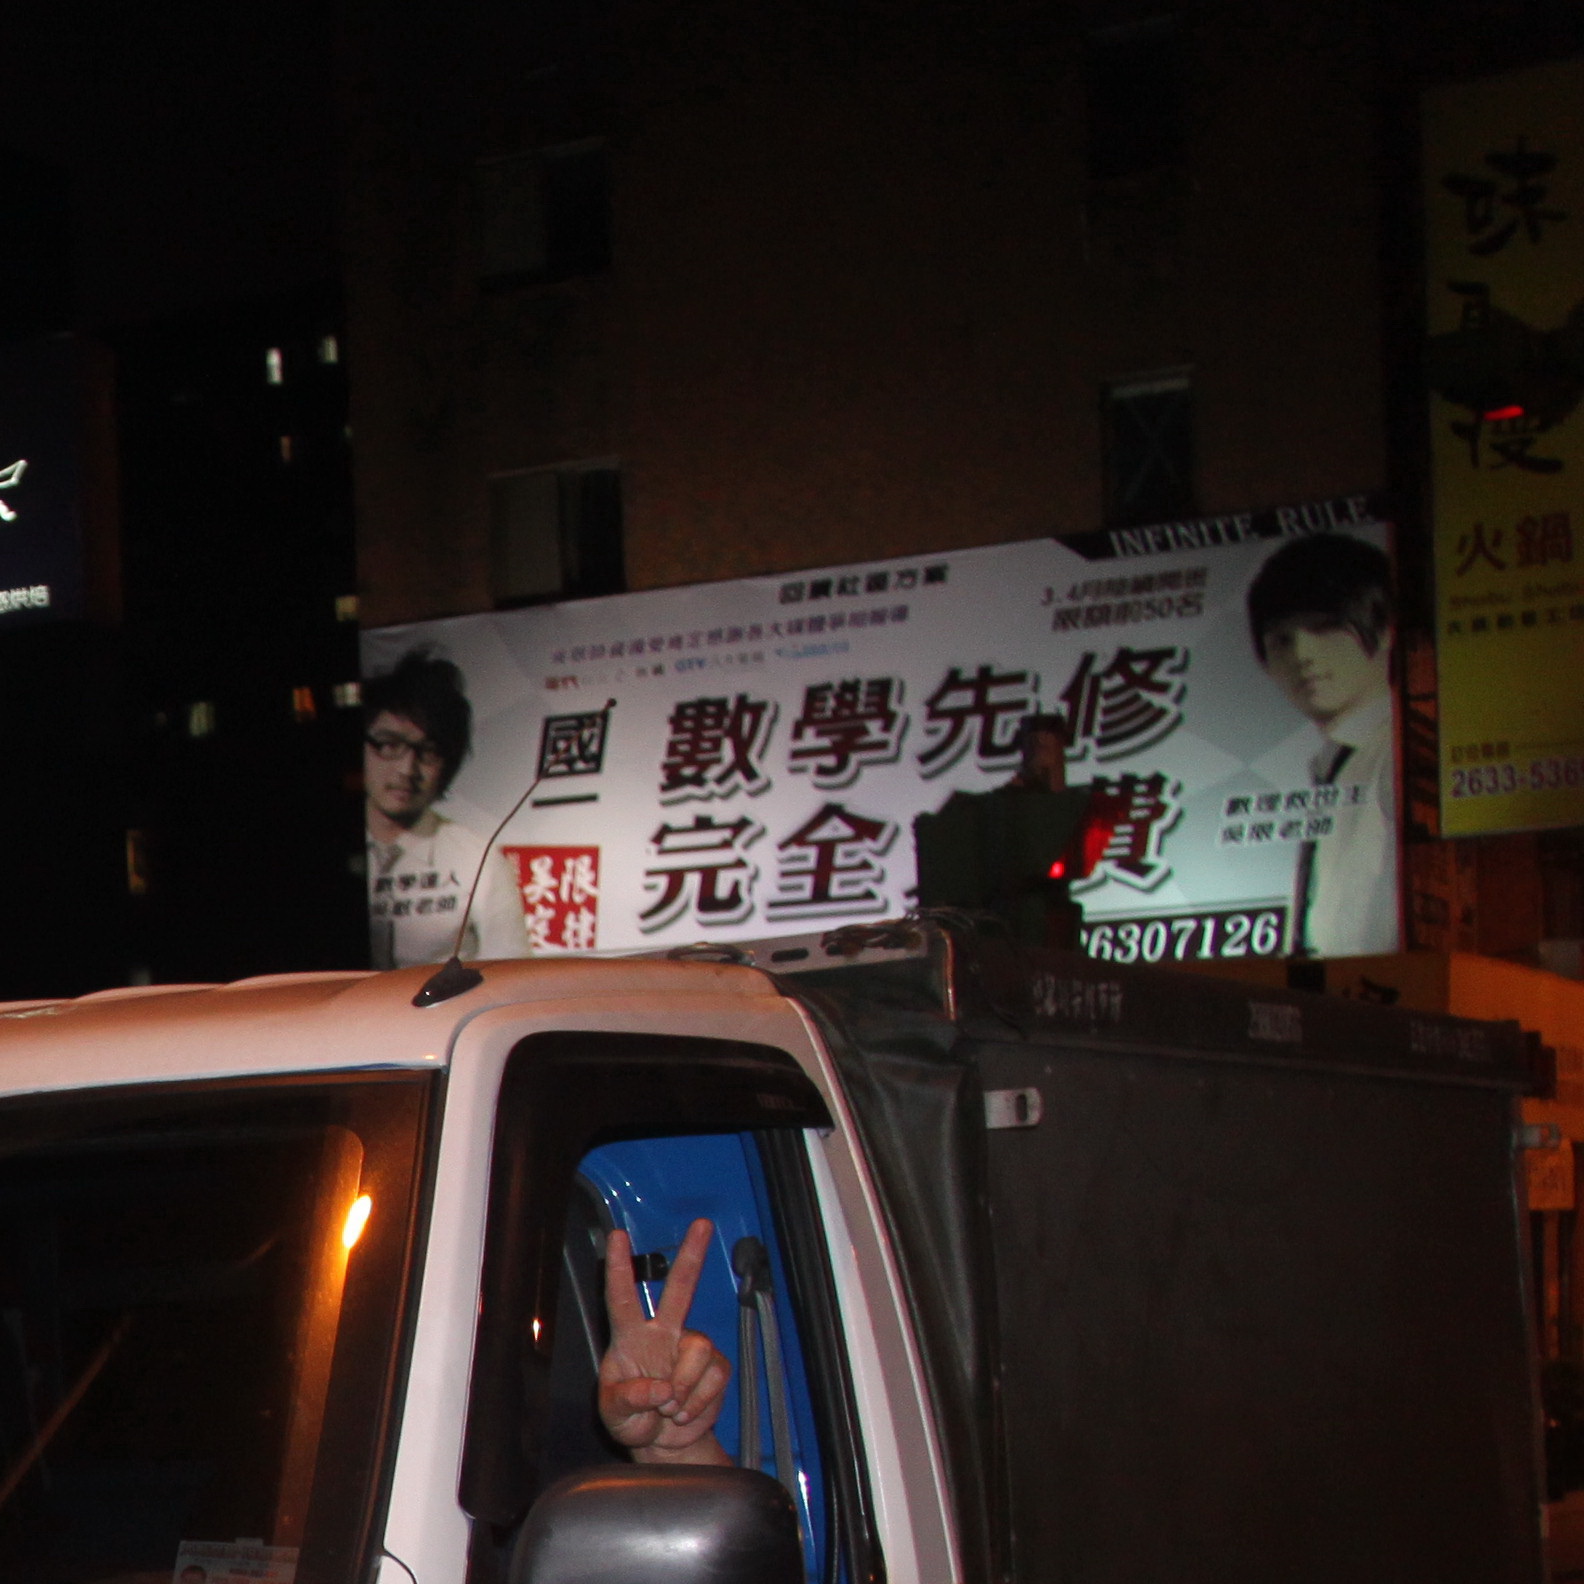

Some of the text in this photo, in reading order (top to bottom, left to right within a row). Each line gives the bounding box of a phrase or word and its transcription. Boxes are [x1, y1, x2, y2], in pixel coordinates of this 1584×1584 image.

[1109, 496, 1374, 558] INFINITE RULE
[1456, 513, 1573, 577] 火鍋
[656, 646, 1186, 800] 數學先修
[639, 771, 1182, 932] 完全費
[1080, 911, 1279, 964] 6307126
